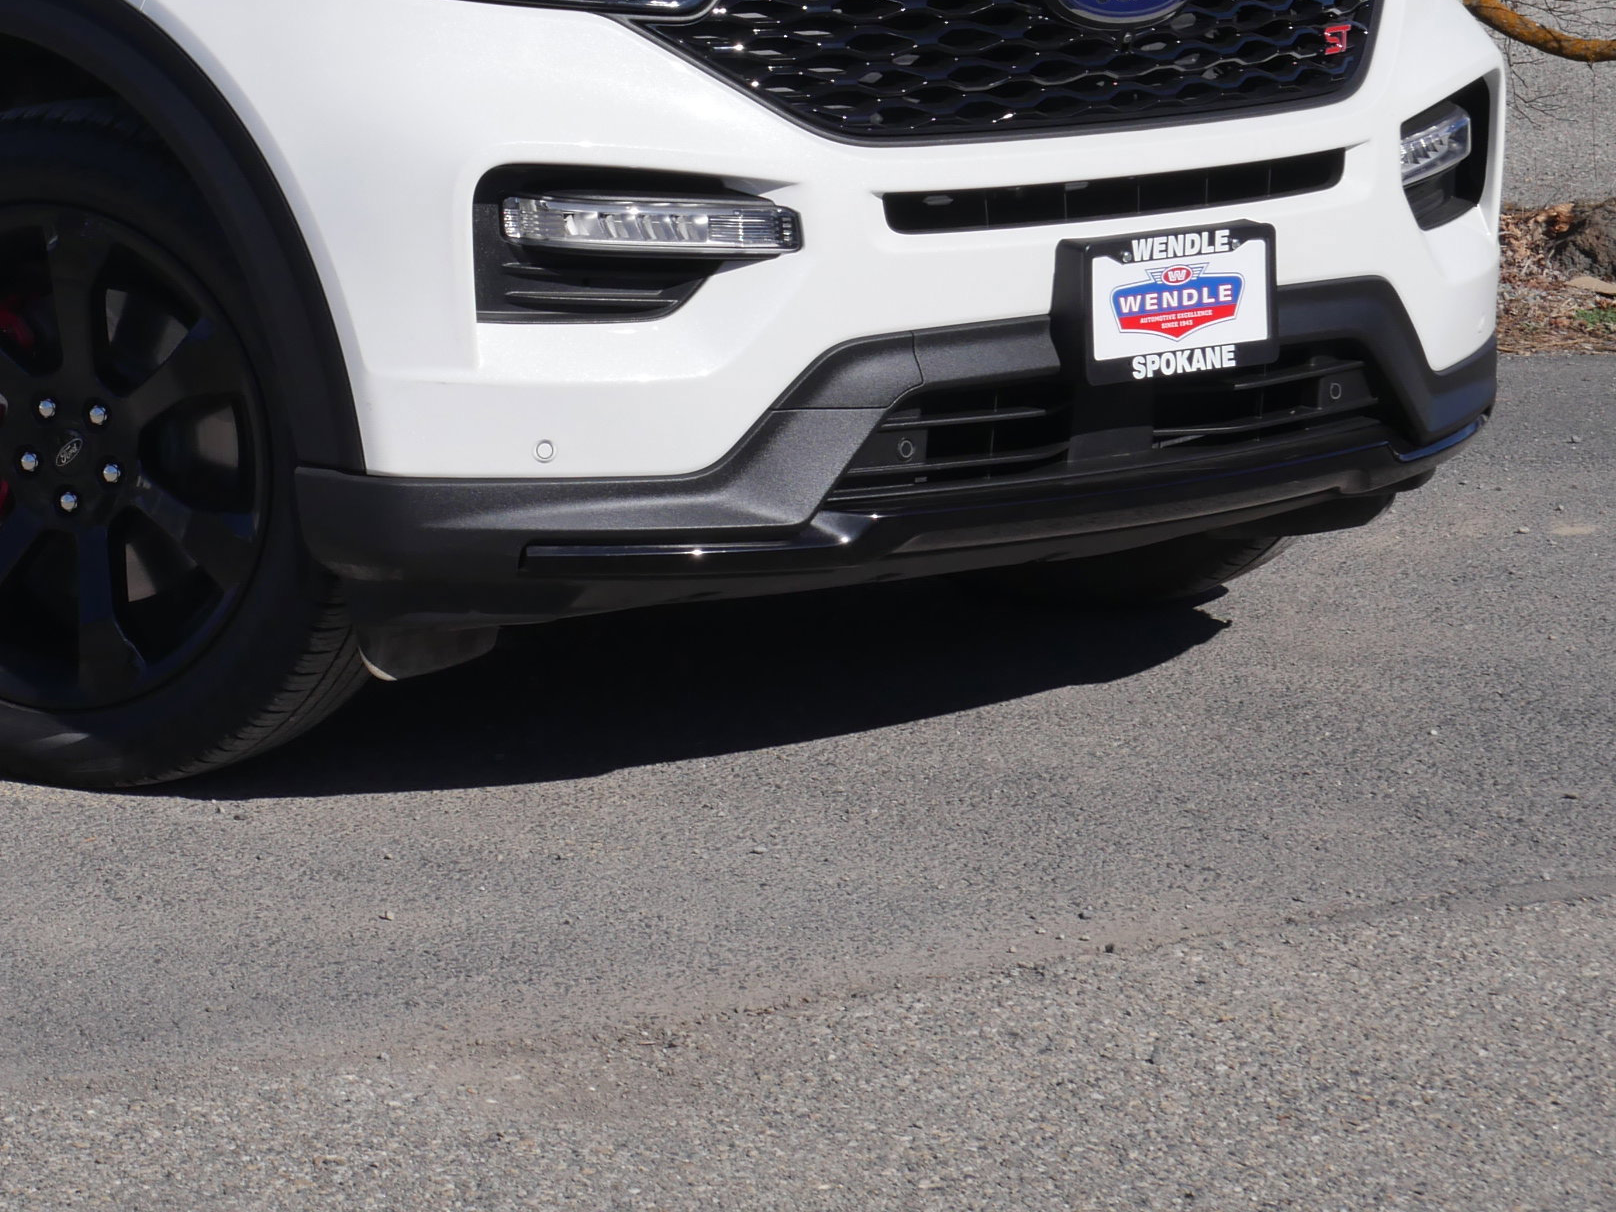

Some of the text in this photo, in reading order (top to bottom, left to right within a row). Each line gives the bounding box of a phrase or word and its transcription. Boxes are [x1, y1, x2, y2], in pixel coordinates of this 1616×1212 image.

[1324, 24, 1352, 55] ST
[1132, 229, 1231, 262] WENDLE
[1119, 285, 1233, 314] WENDLE
[1140, 309, 1213, 324] AUTOMOTIVE EXCELLENCE
[1132, 345, 1237, 380] SPOKANE
